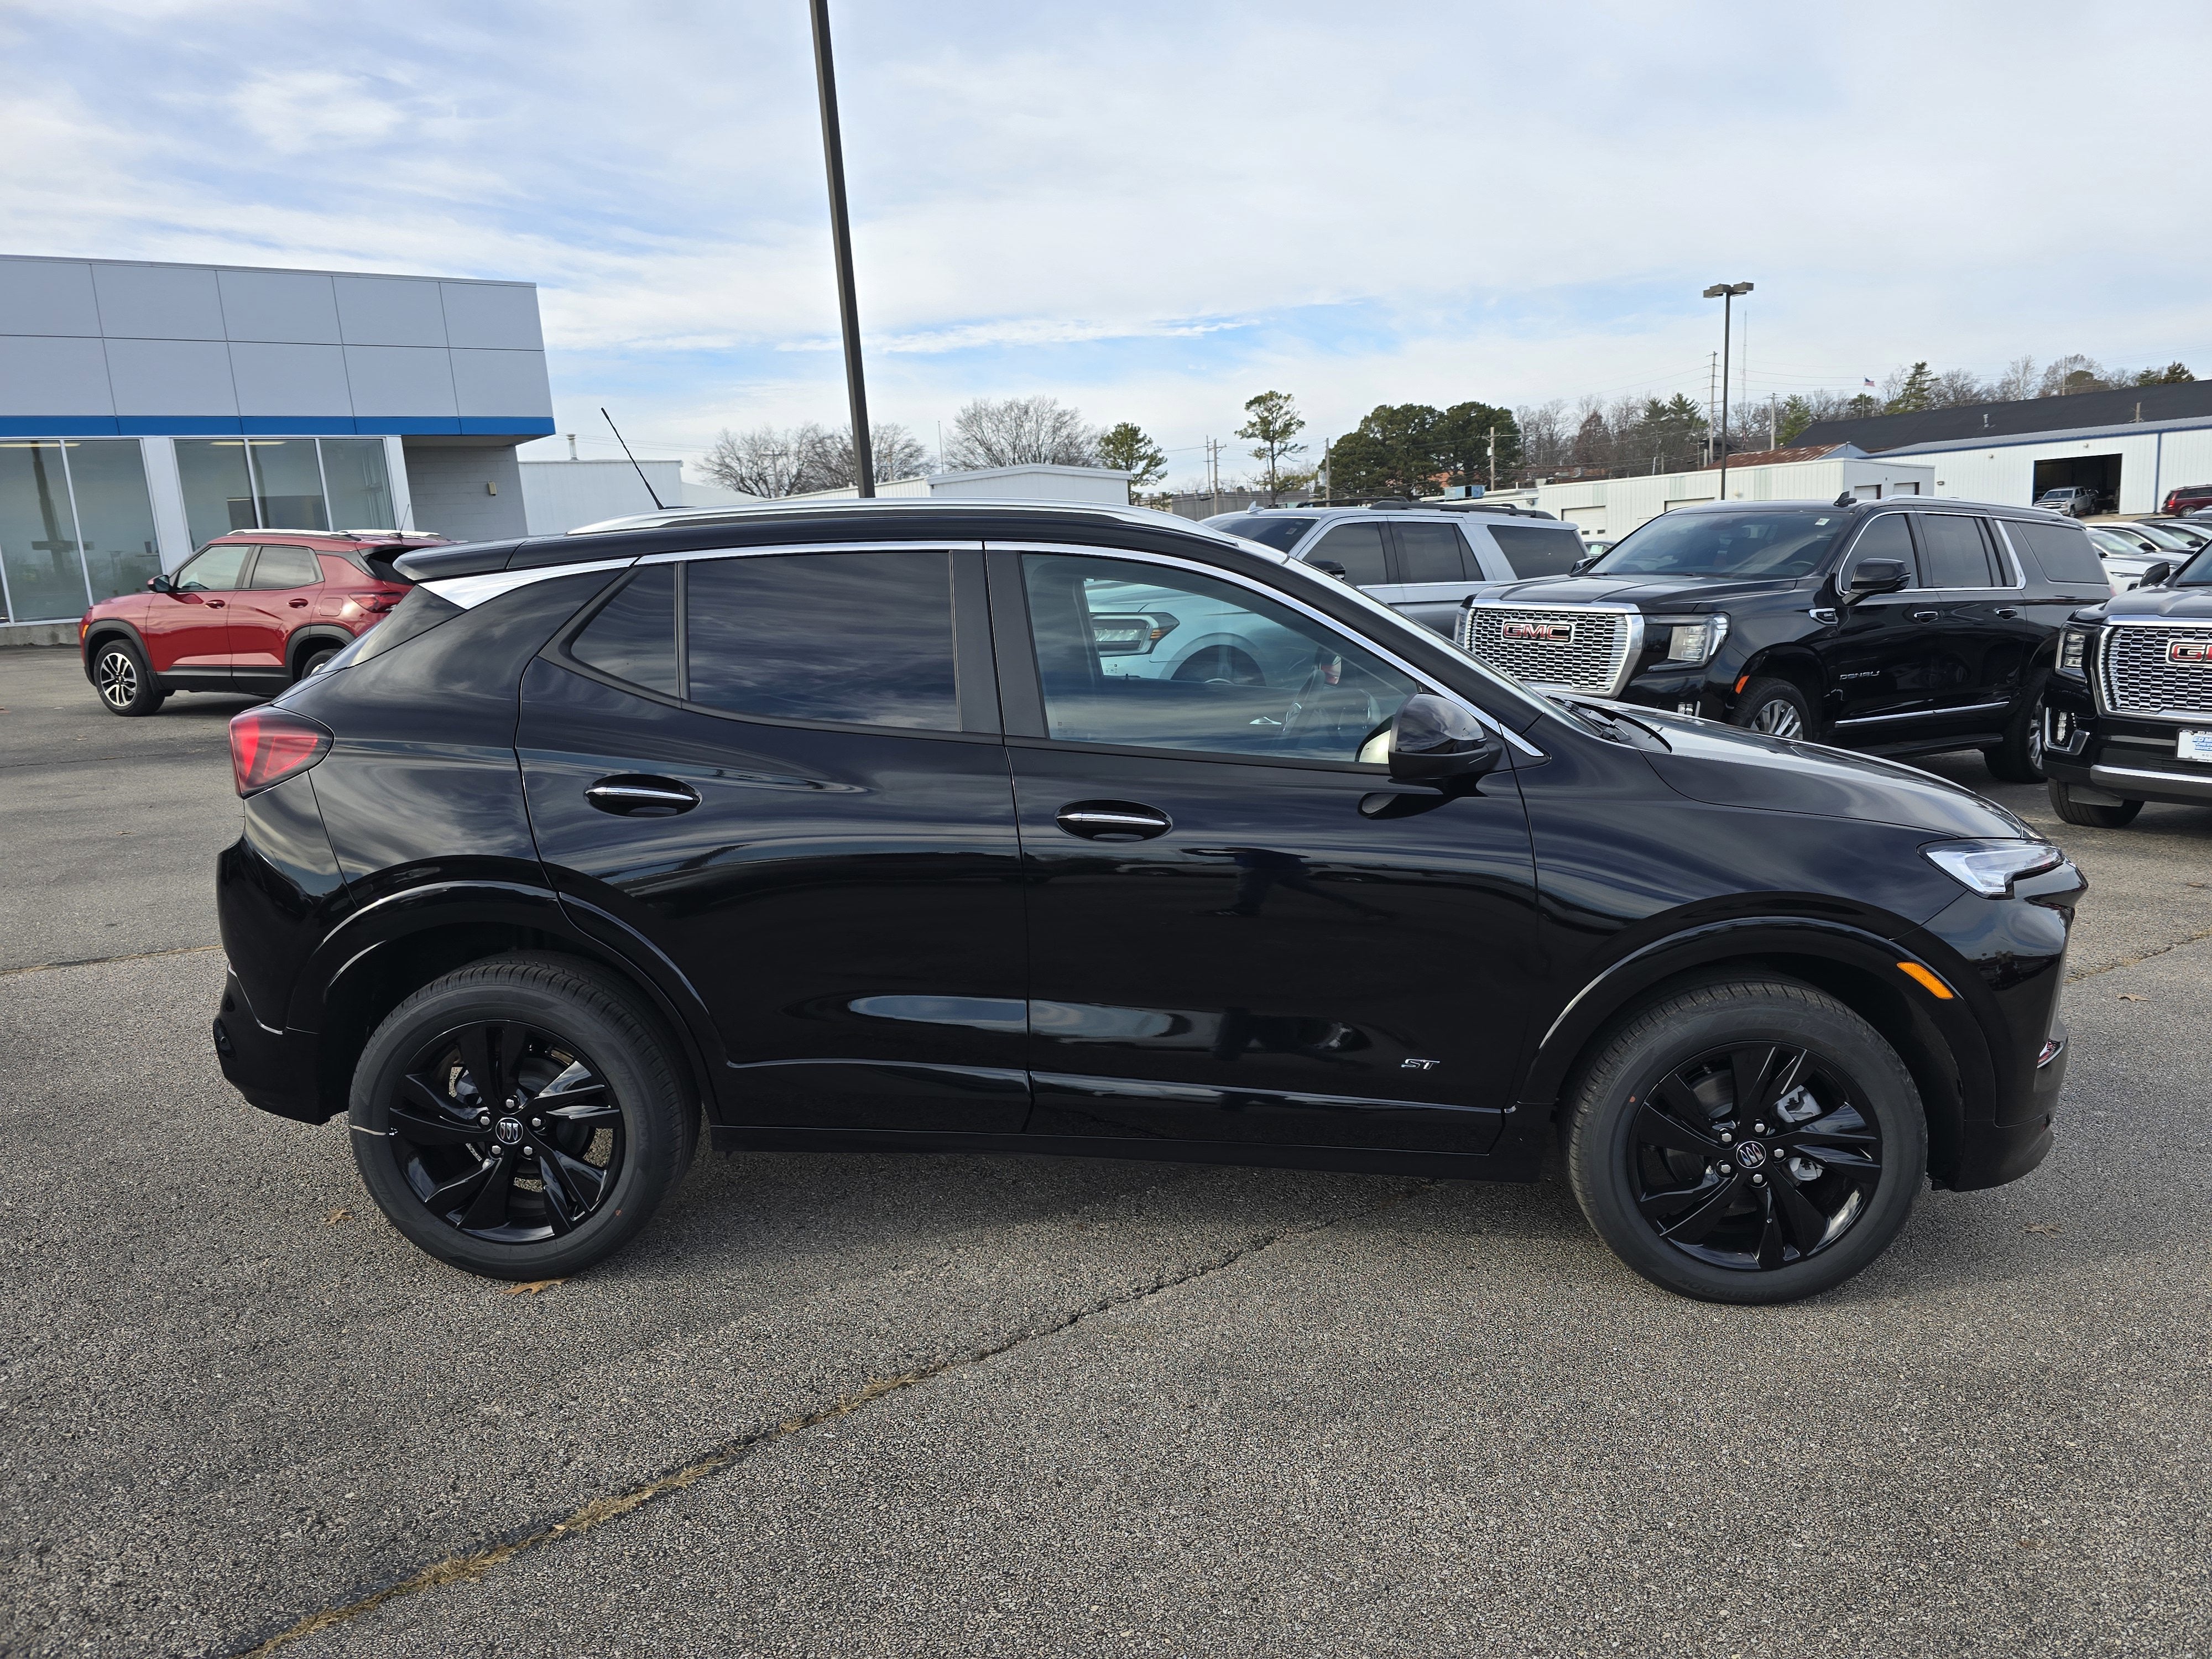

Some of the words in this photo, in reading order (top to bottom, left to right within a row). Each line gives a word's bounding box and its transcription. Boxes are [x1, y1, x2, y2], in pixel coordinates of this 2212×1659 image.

[1503, 623, 1570, 640] GMC
[1839, 670, 1880, 681] DENALI
[1401, 1058, 1441, 1070] ST
